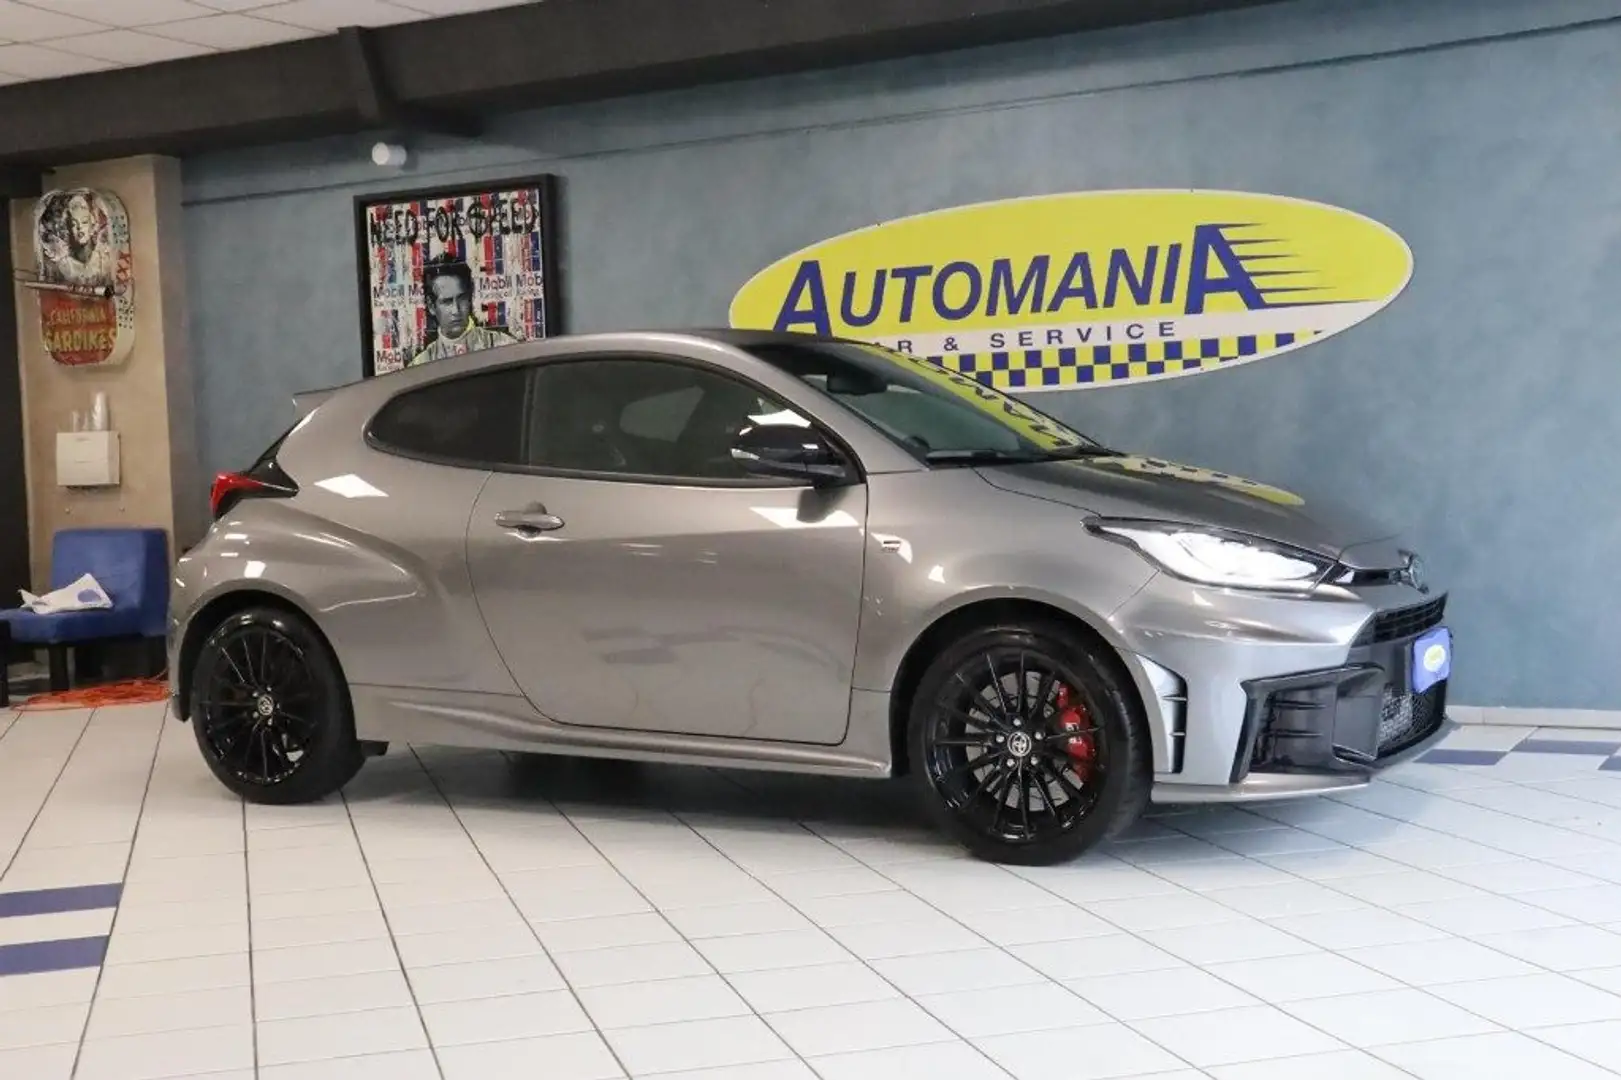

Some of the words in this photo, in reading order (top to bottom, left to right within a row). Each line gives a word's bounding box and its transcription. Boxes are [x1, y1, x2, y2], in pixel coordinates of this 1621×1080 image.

[772, 223, 1268, 339] AUTOMANIA
[943, 337, 959, 351] &
[990, 320, 1176, 349] SERVICE
